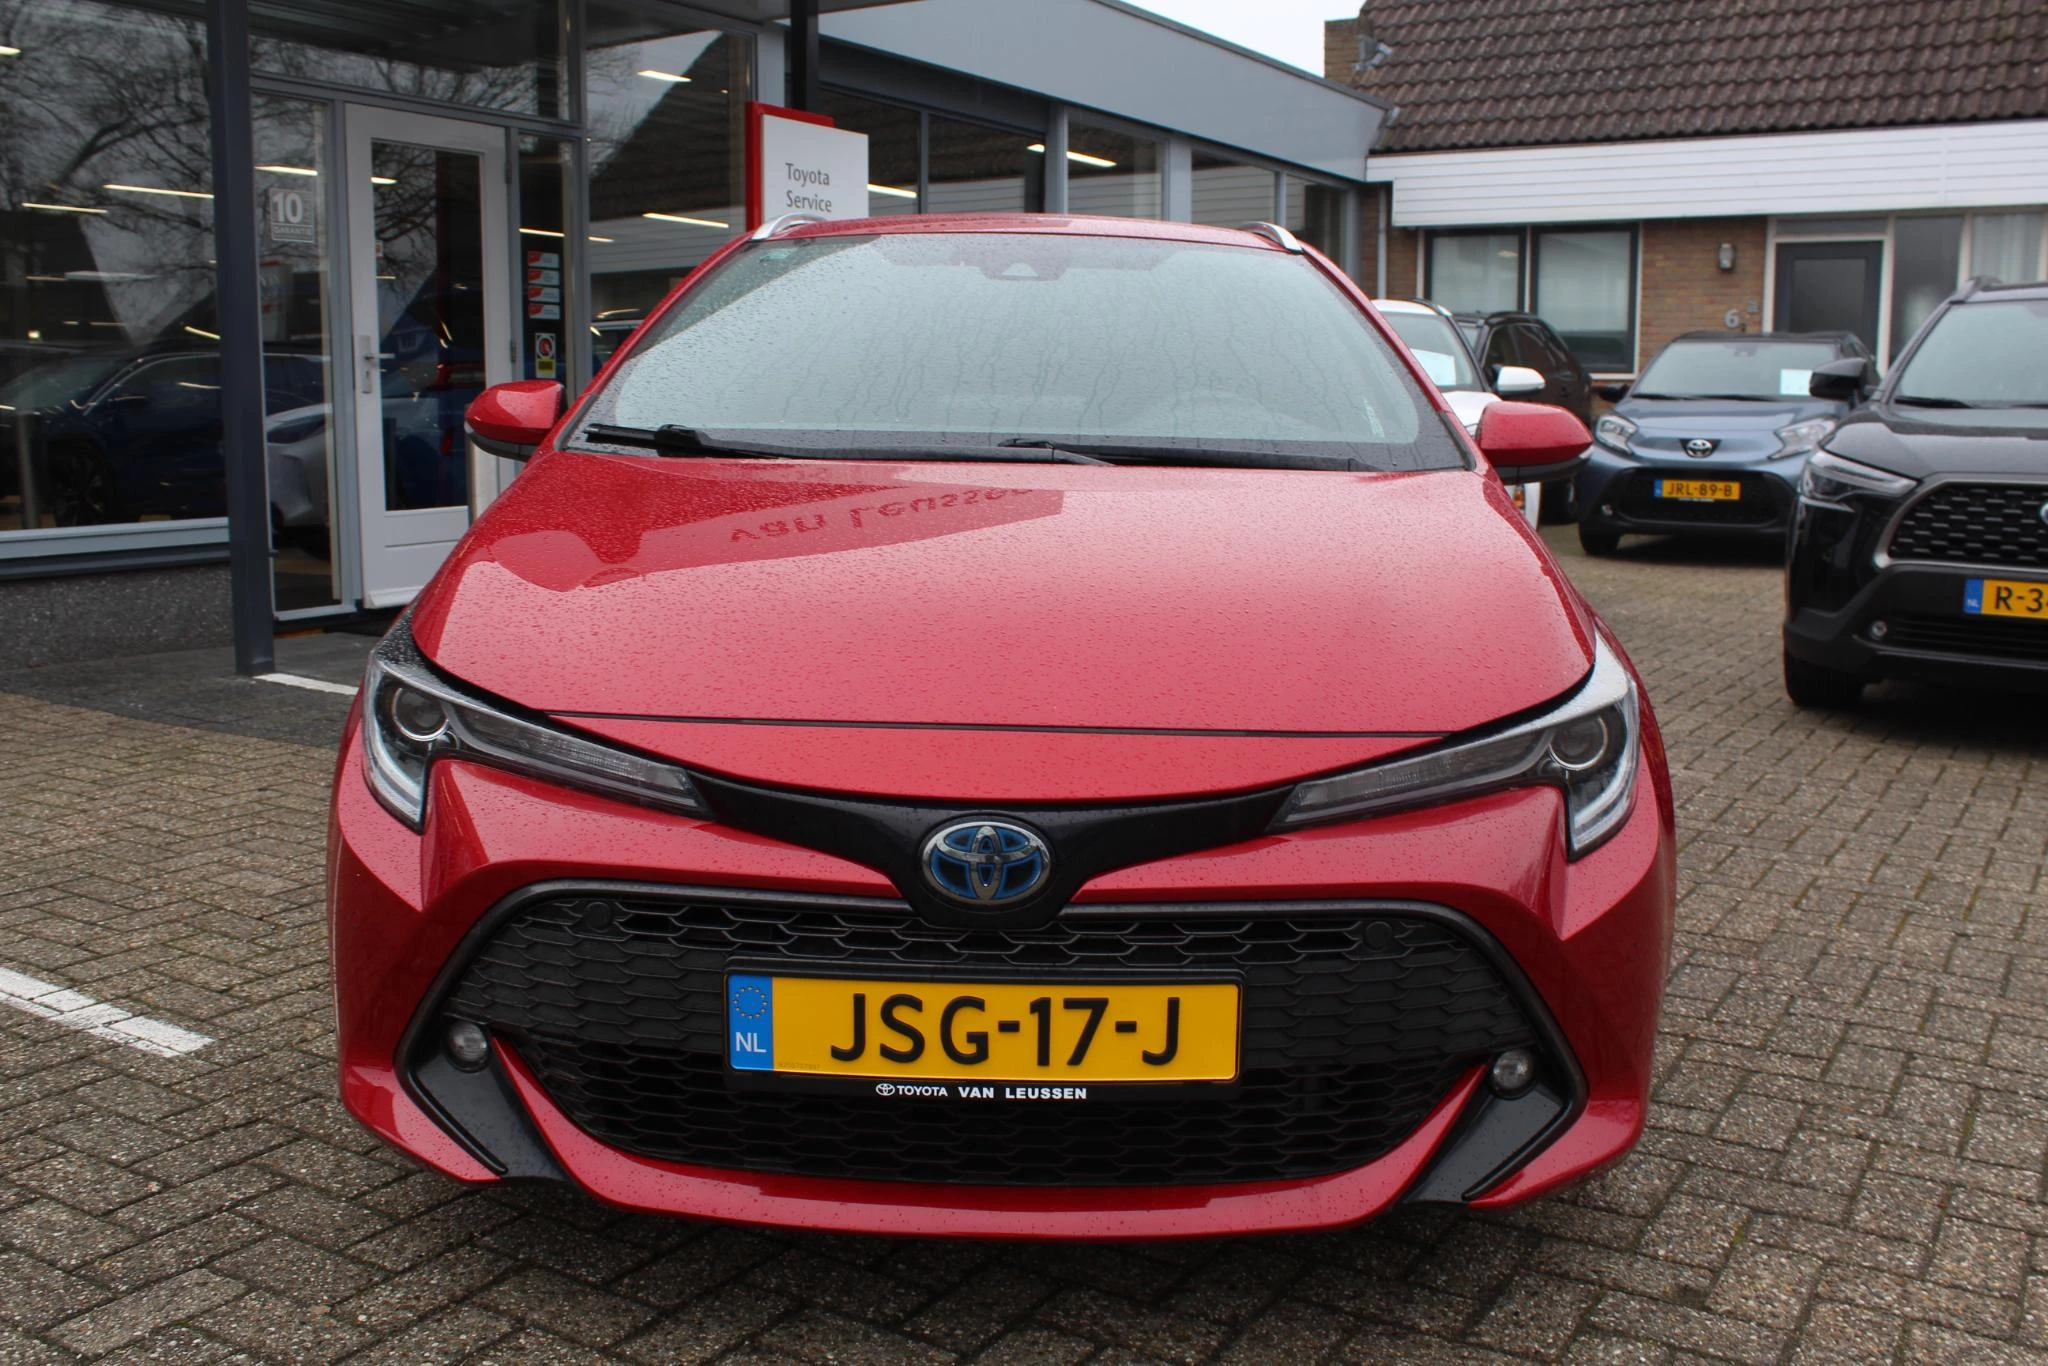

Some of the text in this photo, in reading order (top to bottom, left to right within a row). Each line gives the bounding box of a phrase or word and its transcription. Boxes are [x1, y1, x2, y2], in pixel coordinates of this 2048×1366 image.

[785, 162, 830, 188] Toyota
[272, 191, 303, 224] 10
[786, 189, 832, 213] Service
[1724, 308, 1740, 329] 6
[1994, 585, 2048, 613] R-3
[830, 992, 1181, 1067] JSG-17-J
[735, 1031, 767, 1054] NL
[897, 1084, 1087, 1100] TOYOTA VAN LEUSSEN
